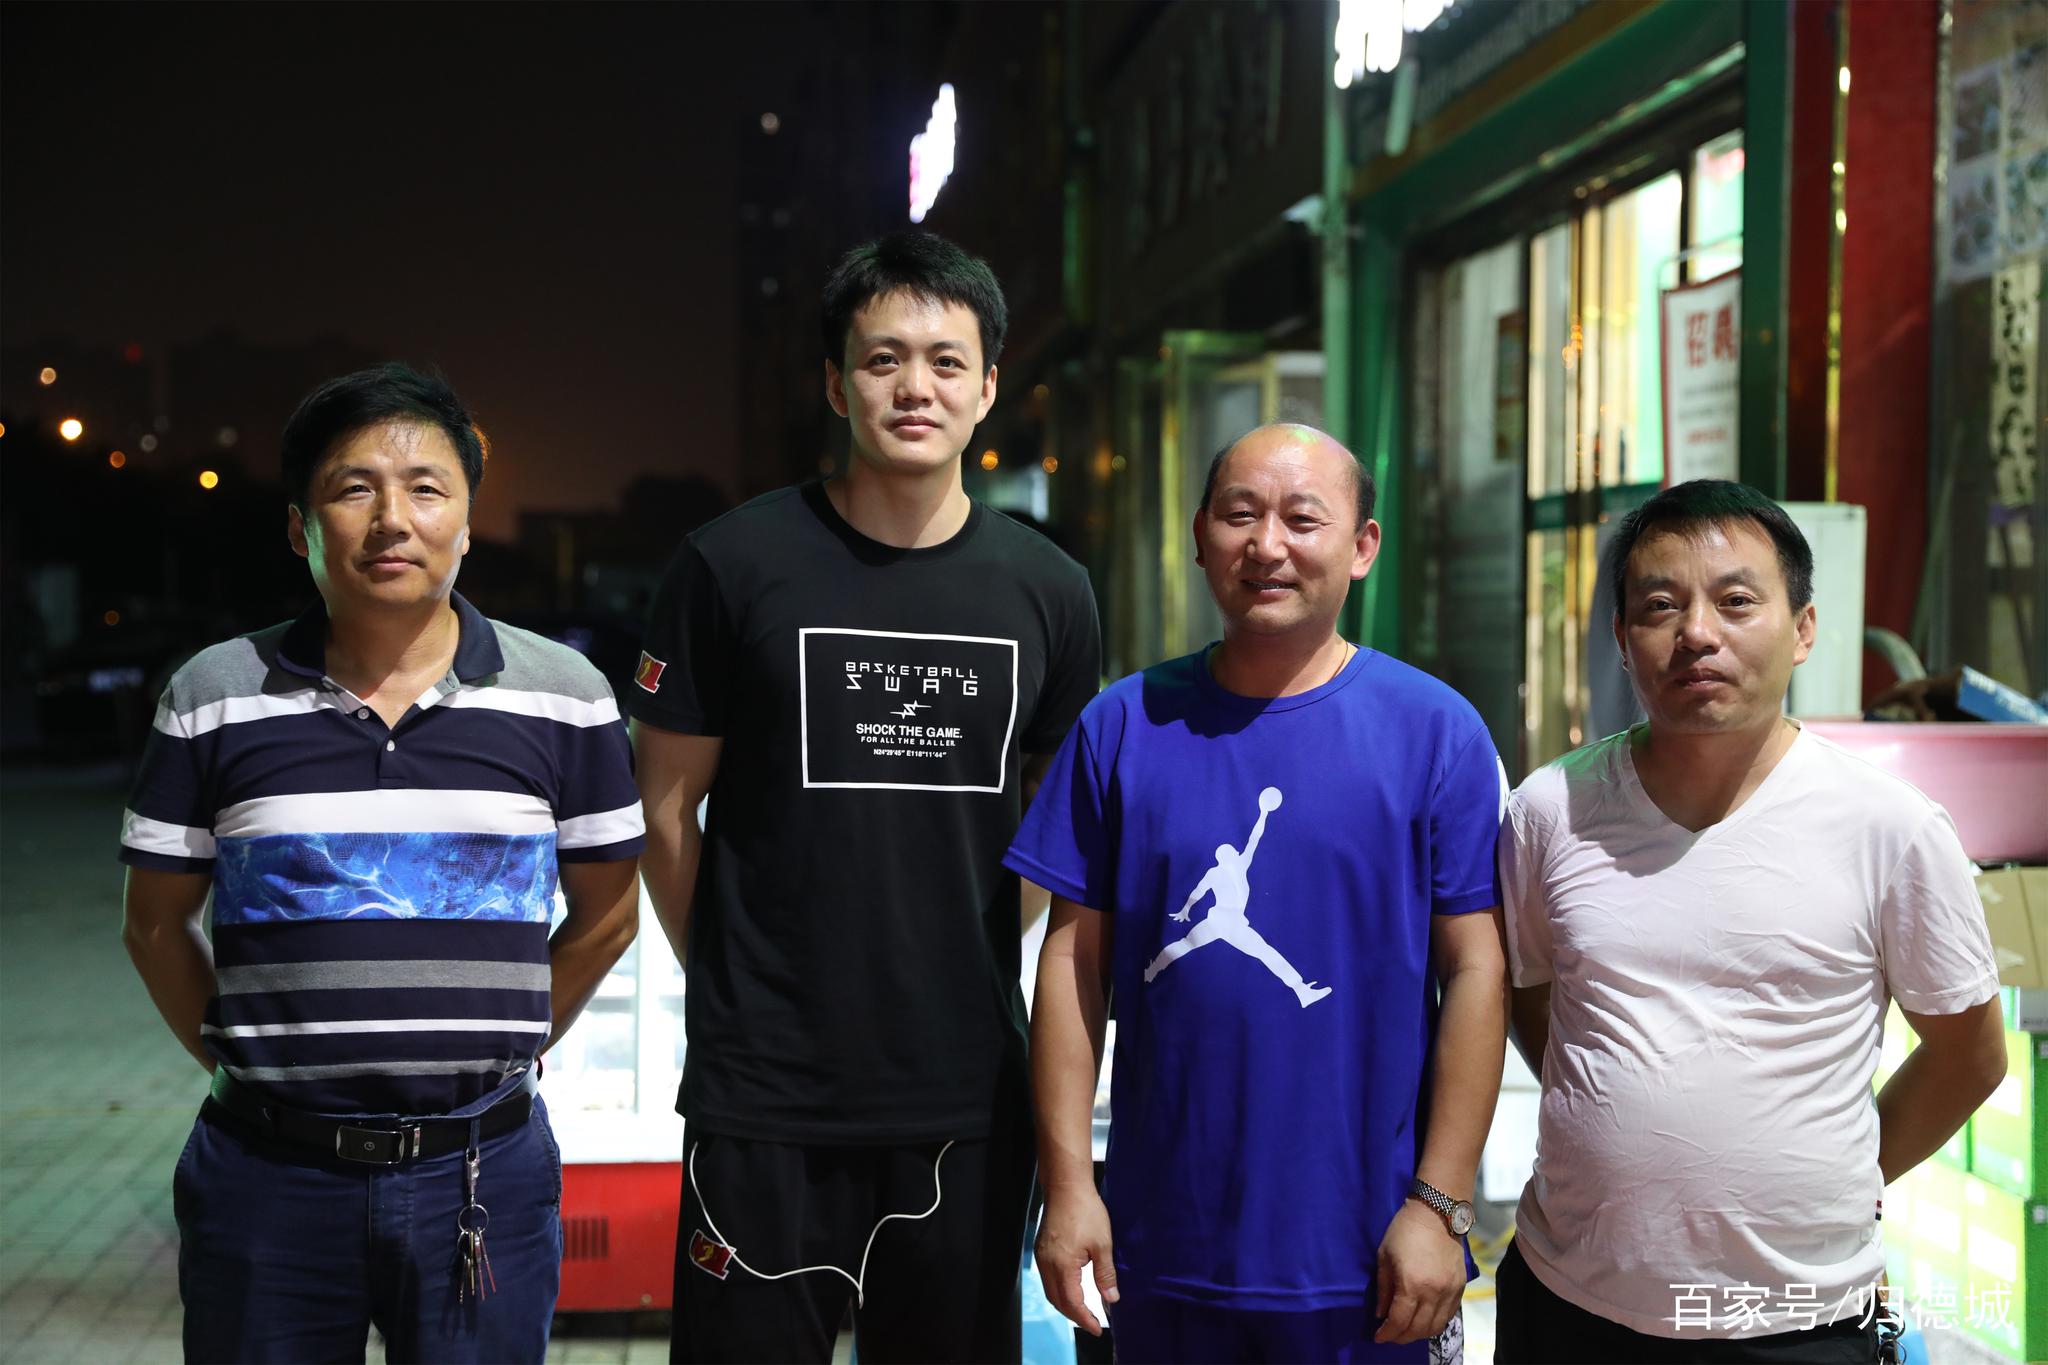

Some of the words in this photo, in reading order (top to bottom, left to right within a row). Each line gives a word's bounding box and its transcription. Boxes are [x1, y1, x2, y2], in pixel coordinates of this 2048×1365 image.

[845, 662, 978, 678] BASKETBALL
[856, 723, 896, 735] SHOCK
[899, 725, 923, 737] THE
[926, 727, 963, 738] GAME.
[898, 737, 915, 745] THE
